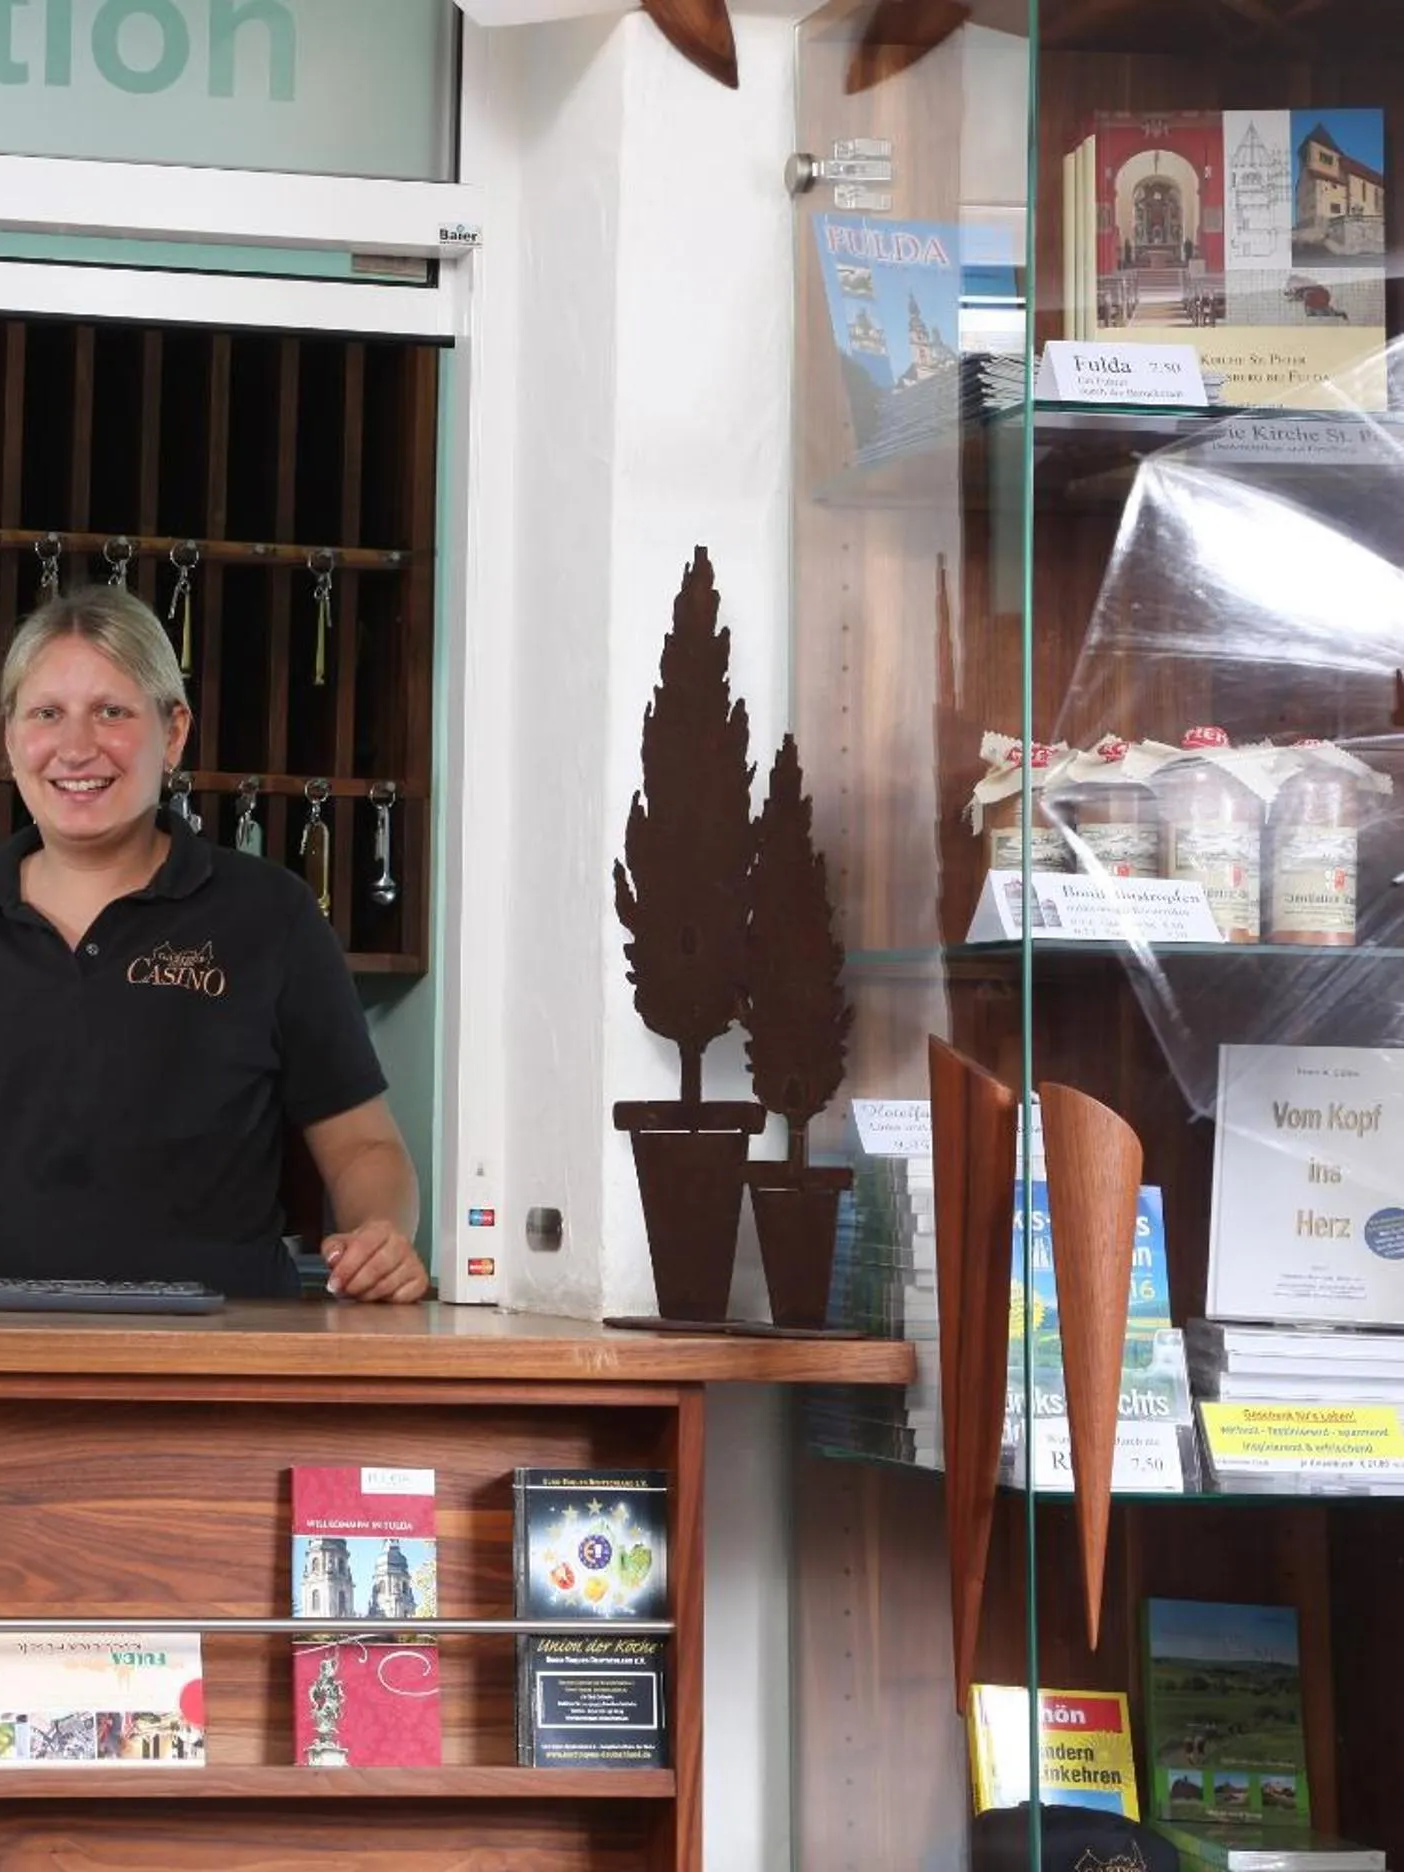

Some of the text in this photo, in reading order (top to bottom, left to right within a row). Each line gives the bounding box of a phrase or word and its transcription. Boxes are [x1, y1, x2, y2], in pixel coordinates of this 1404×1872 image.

[439, 225, 478, 242] Baier
[826, 225, 950, 267] FULDA
[1074, 355, 1132, 374] Fulda
[1252, 425, 1320, 443] Kirche
[127, 956, 226, 997] CASINO
[1272, 1100, 1383, 1137] Vom Kopf
[1308, 1157, 1343, 1184] ins
[1296, 1209, 1351, 1239] Herz
